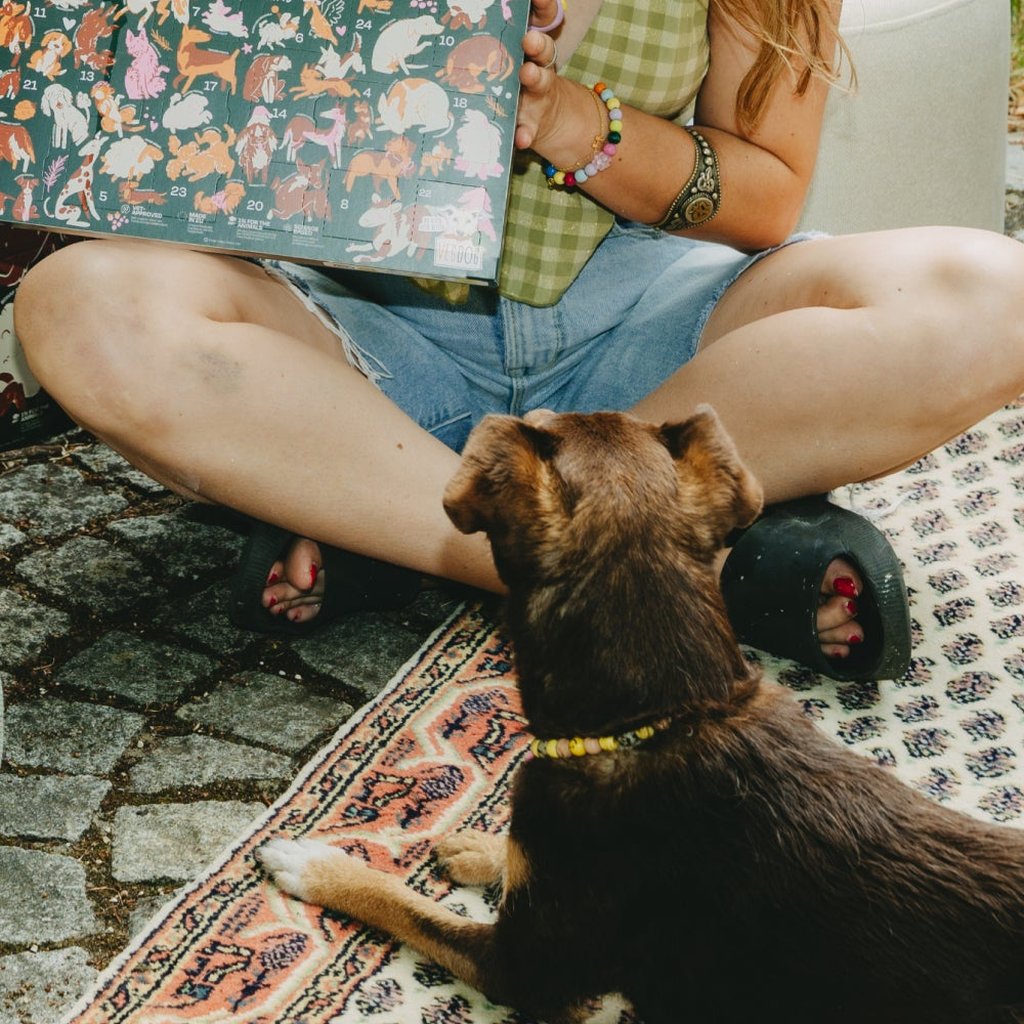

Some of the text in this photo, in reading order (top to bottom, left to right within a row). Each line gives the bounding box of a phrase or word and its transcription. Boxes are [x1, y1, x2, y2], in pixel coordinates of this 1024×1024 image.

[34, 8, 46, 18] 11
[192, 7, 200, 17] 7
[355, 19, 372, 30] 24
[296, 33, 304, 43] 6
[439, 35, 454, 46] 10
[80, 71, 95, 82] 13
[23, 80, 37, 90] 21
[203, 80, 218, 91] 17
[363, 88, 371, 98] 4
[453, 98, 467, 108] 18
[272, 108, 287, 120] 14
[99, 191, 108, 202] 5
[170, 186, 187, 198] 23
[418, 188, 432, 198] 22
[247, 200, 263, 212] 20
[340, 199, 349, 210] 8
